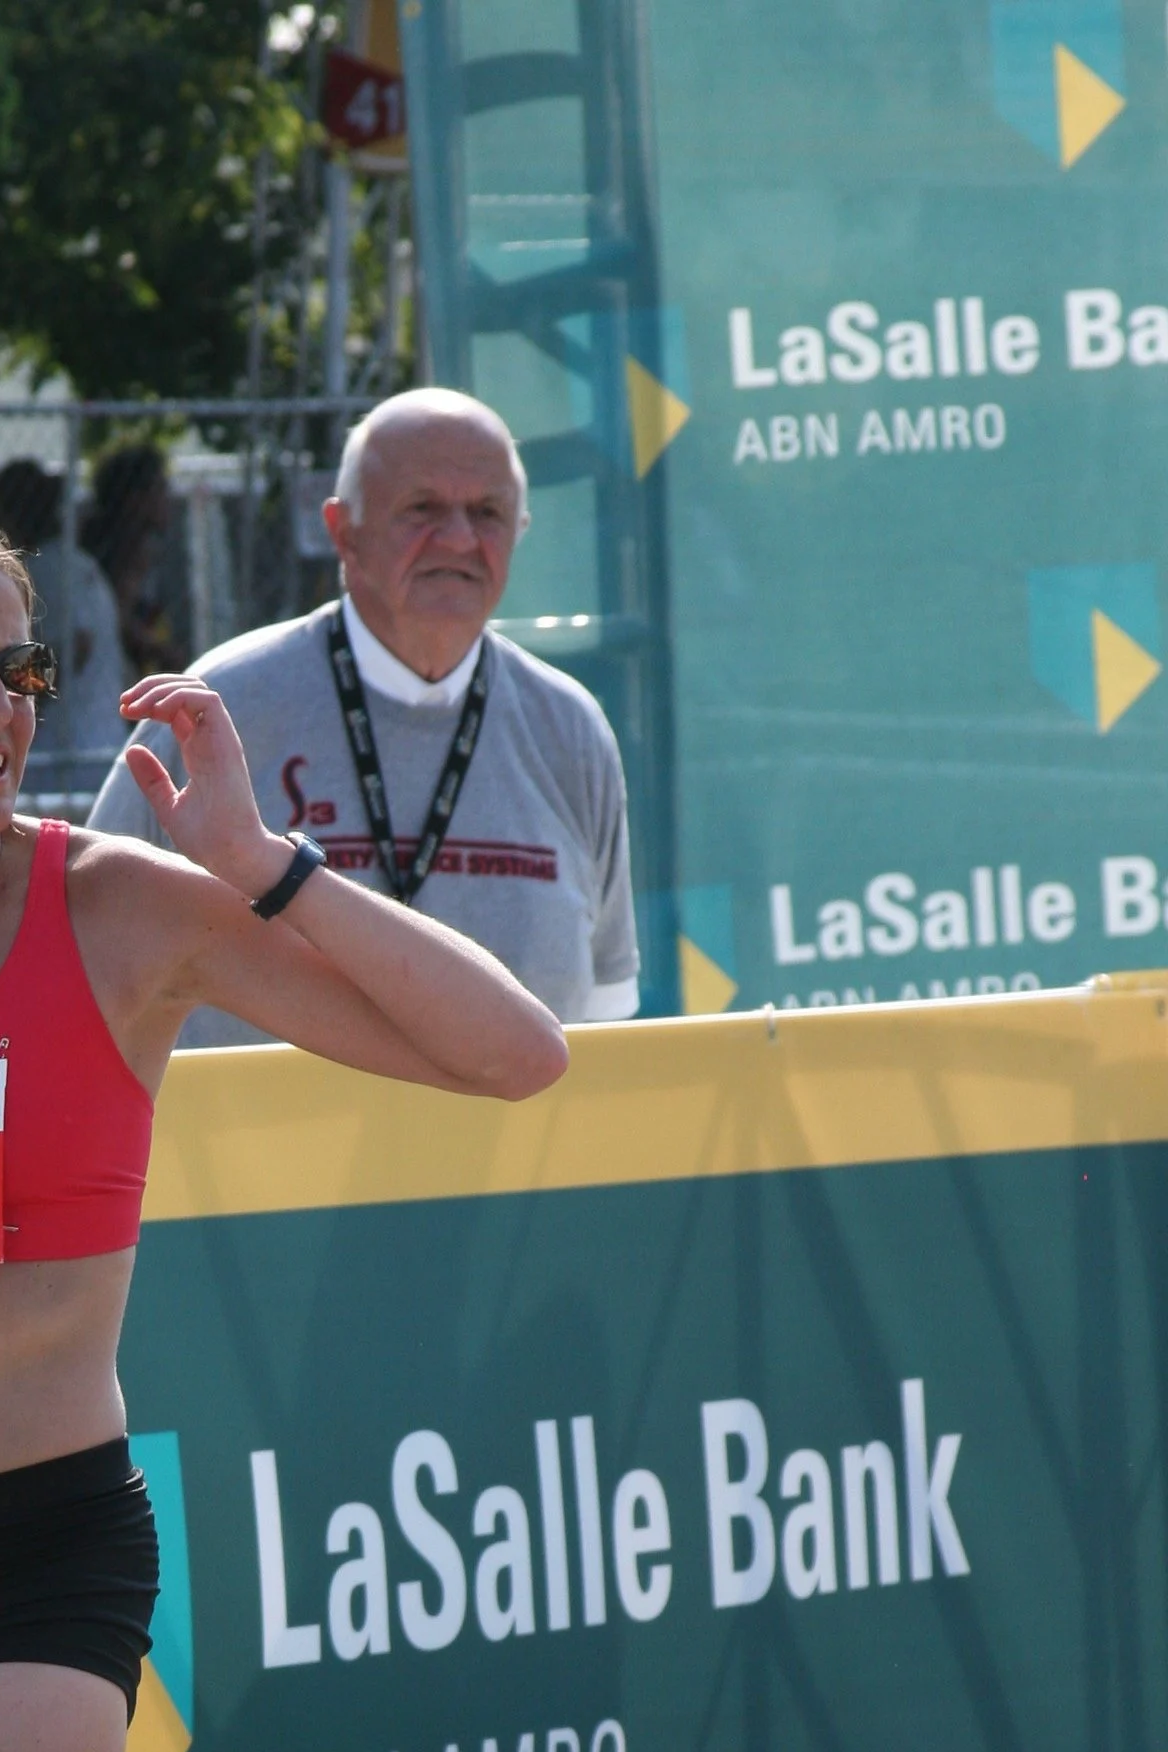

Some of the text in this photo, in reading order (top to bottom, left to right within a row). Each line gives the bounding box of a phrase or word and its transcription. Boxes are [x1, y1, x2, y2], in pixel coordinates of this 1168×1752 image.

[729, 296, 1040, 389] LaSalle
[734, 403, 1006, 465] ABN AMRO
[769, 855, 1168, 966] LaSalle B
[250, 1377, 971, 1669] LaSalle Bank
